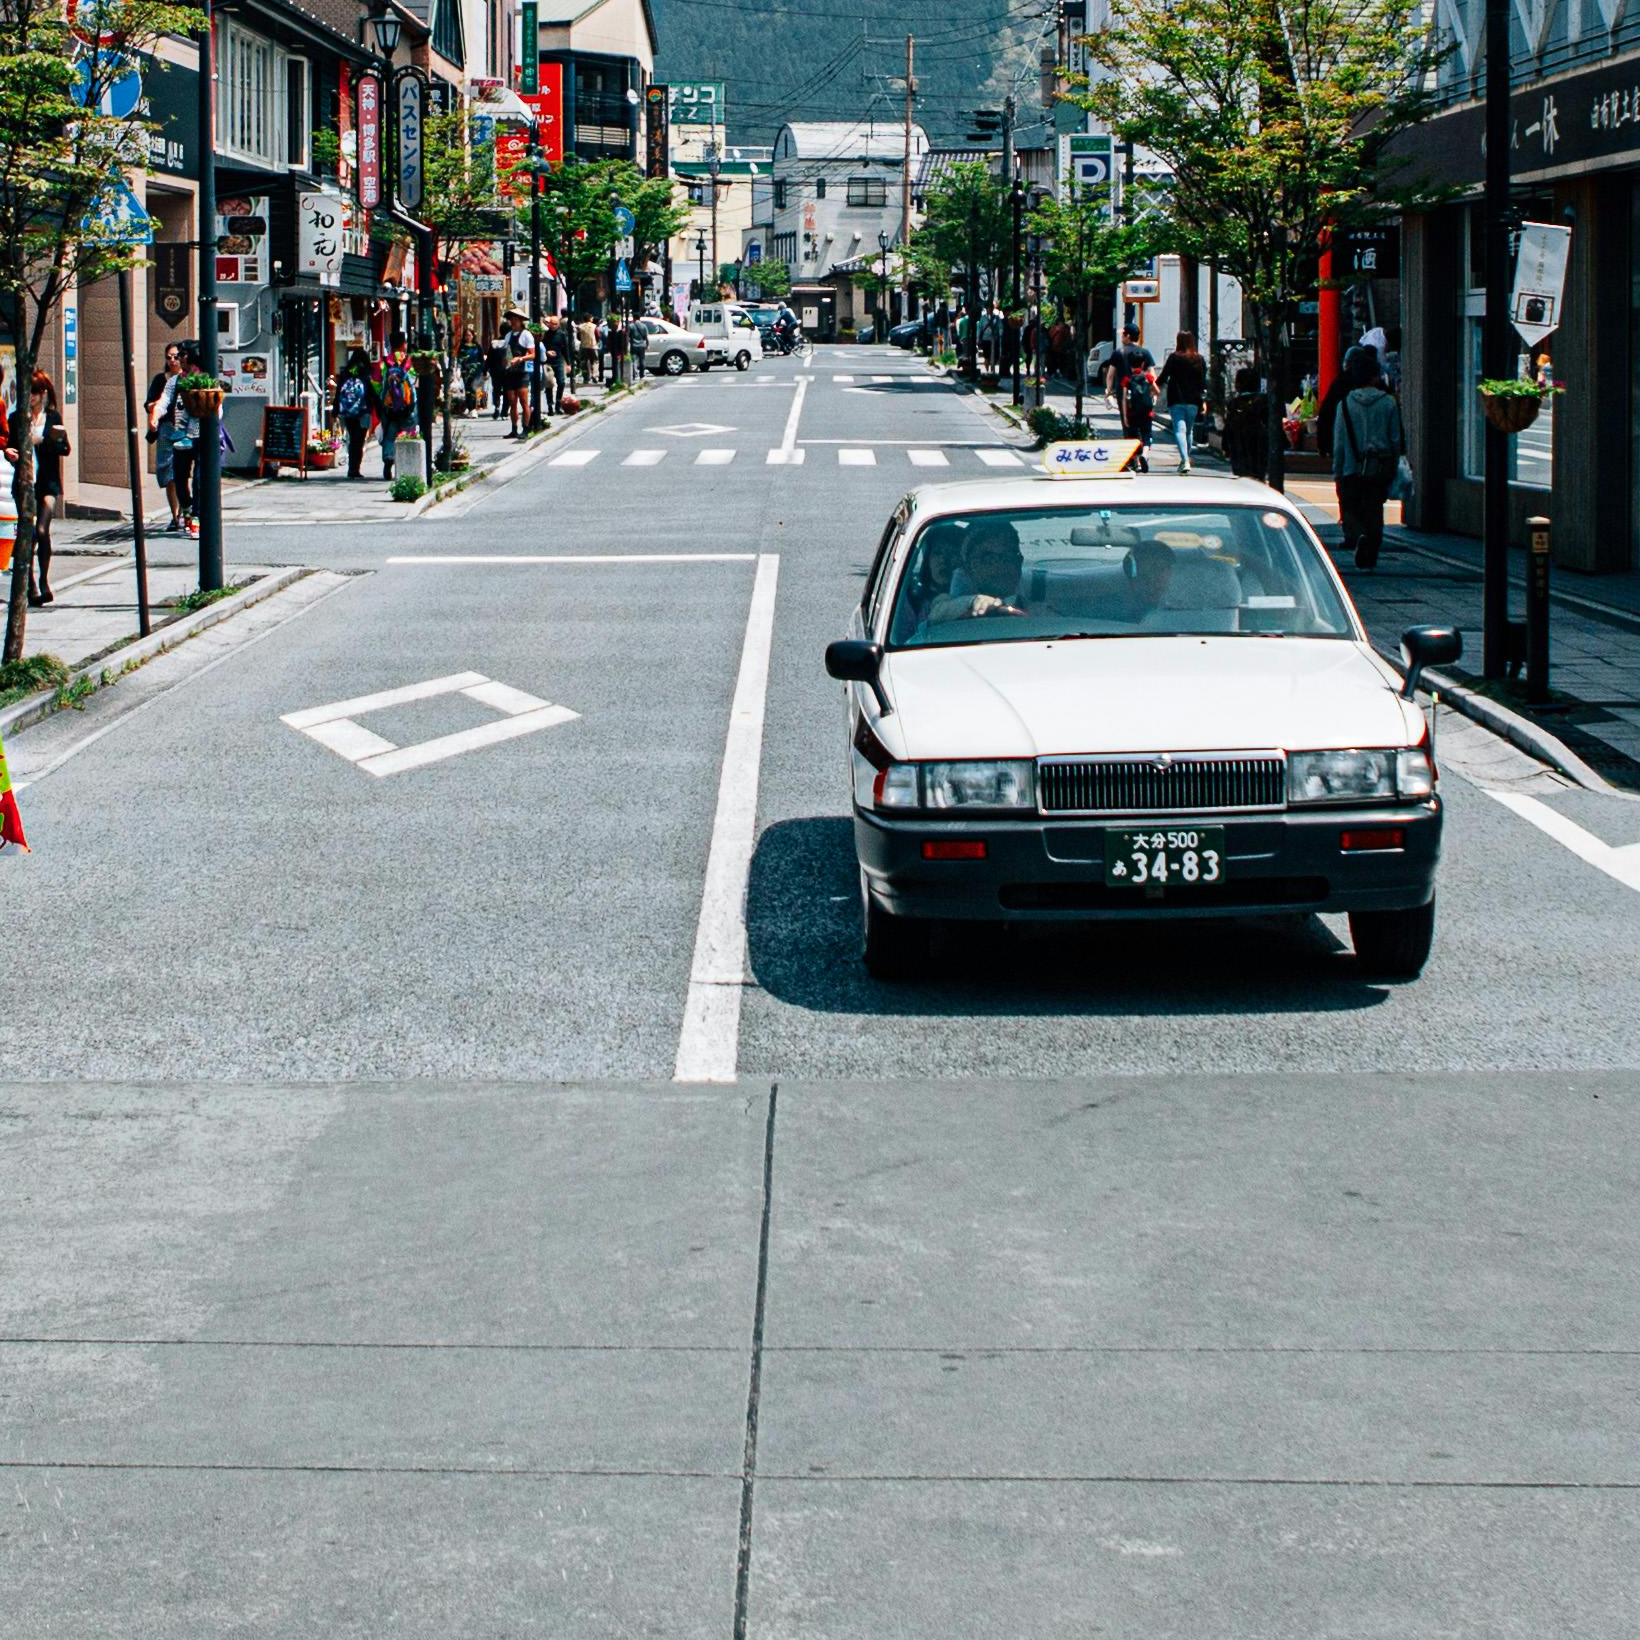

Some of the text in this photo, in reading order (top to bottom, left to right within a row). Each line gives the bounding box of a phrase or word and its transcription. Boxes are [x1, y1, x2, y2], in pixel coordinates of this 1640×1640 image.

[402, 84, 418, 200] バスセンター
[1074, 157, 1107, 184] P
[1055, 448, 1109, 463] みなと
[1112, 849, 1220, 883] あ 34-83
